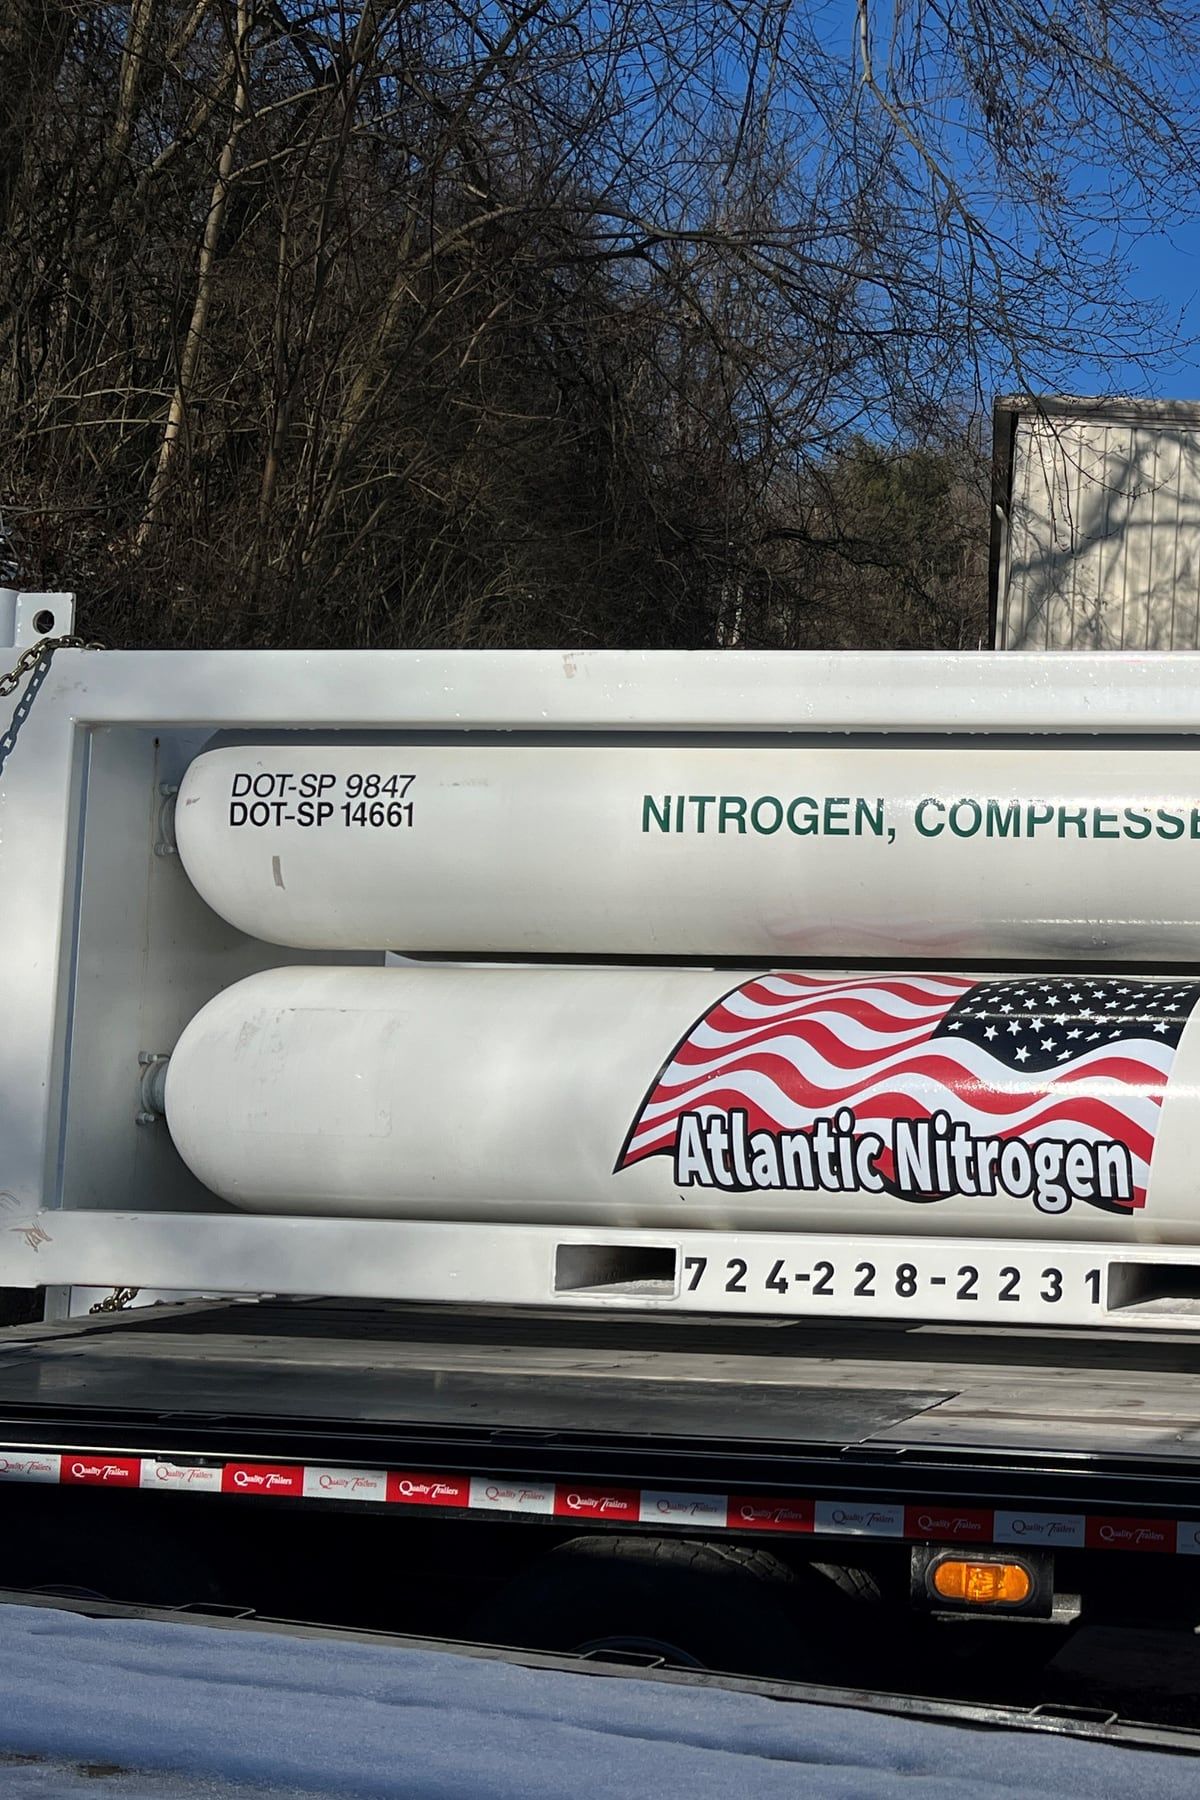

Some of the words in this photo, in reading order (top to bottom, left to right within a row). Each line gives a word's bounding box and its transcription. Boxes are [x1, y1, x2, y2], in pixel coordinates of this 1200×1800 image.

[231, 773, 336, 799] DOT-SP
[345, 774, 416, 799] 9847
[229, 801, 334, 827] DOT-SP
[344, 802, 415, 828] 14661
[641, 794, 897, 844] NITROGEN,
[675, 1107, 884, 1195] Atlantic
[893, 1110, 1134, 1213] Nitrogen
[71, 1463, 101, 1480] Quality
[101, 1464, 128, 1480] Trailers
[156, 1466, 186, 1481] Quality
[185, 1467, 213, 1482] Trailers
[234, 1471, 264, 1487] Quality
[264, 1474, 292, 1488] Trailers
[319, 1474, 349, 1490] Quality
[350, 1477, 377, 1491] Trailers
[399, 1480, 431, 1497] Quality
[431, 1483, 459, 1498] Trailers
[485, 1486, 516, 1501] Quality
[517, 1489, 545, 1503] Trailers
[567, 1493, 599, 1510] Quality
[600, 1497, 627, 1512] Trailers
[657, 1500, 688, 1514] Quality
[688, 1501, 717, 1516] Trailers
[740, 1505, 772, 1521] Quality
[772, 1508, 802, 1523] Trailers
[831, 1510, 864, 1525] Quality
[865, 1512, 895, 1527] Trailers
[918, 1515, 950, 1531] Quality
[951, 1518, 982, 1533] Trailers
[1012, 1519, 1045, 1535] Quality
[1046, 1521, 1075, 1537] Trailers
[1100, 1525, 1133, 1541] Quality
[1135, 1528, 1164, 1544] Trailers
